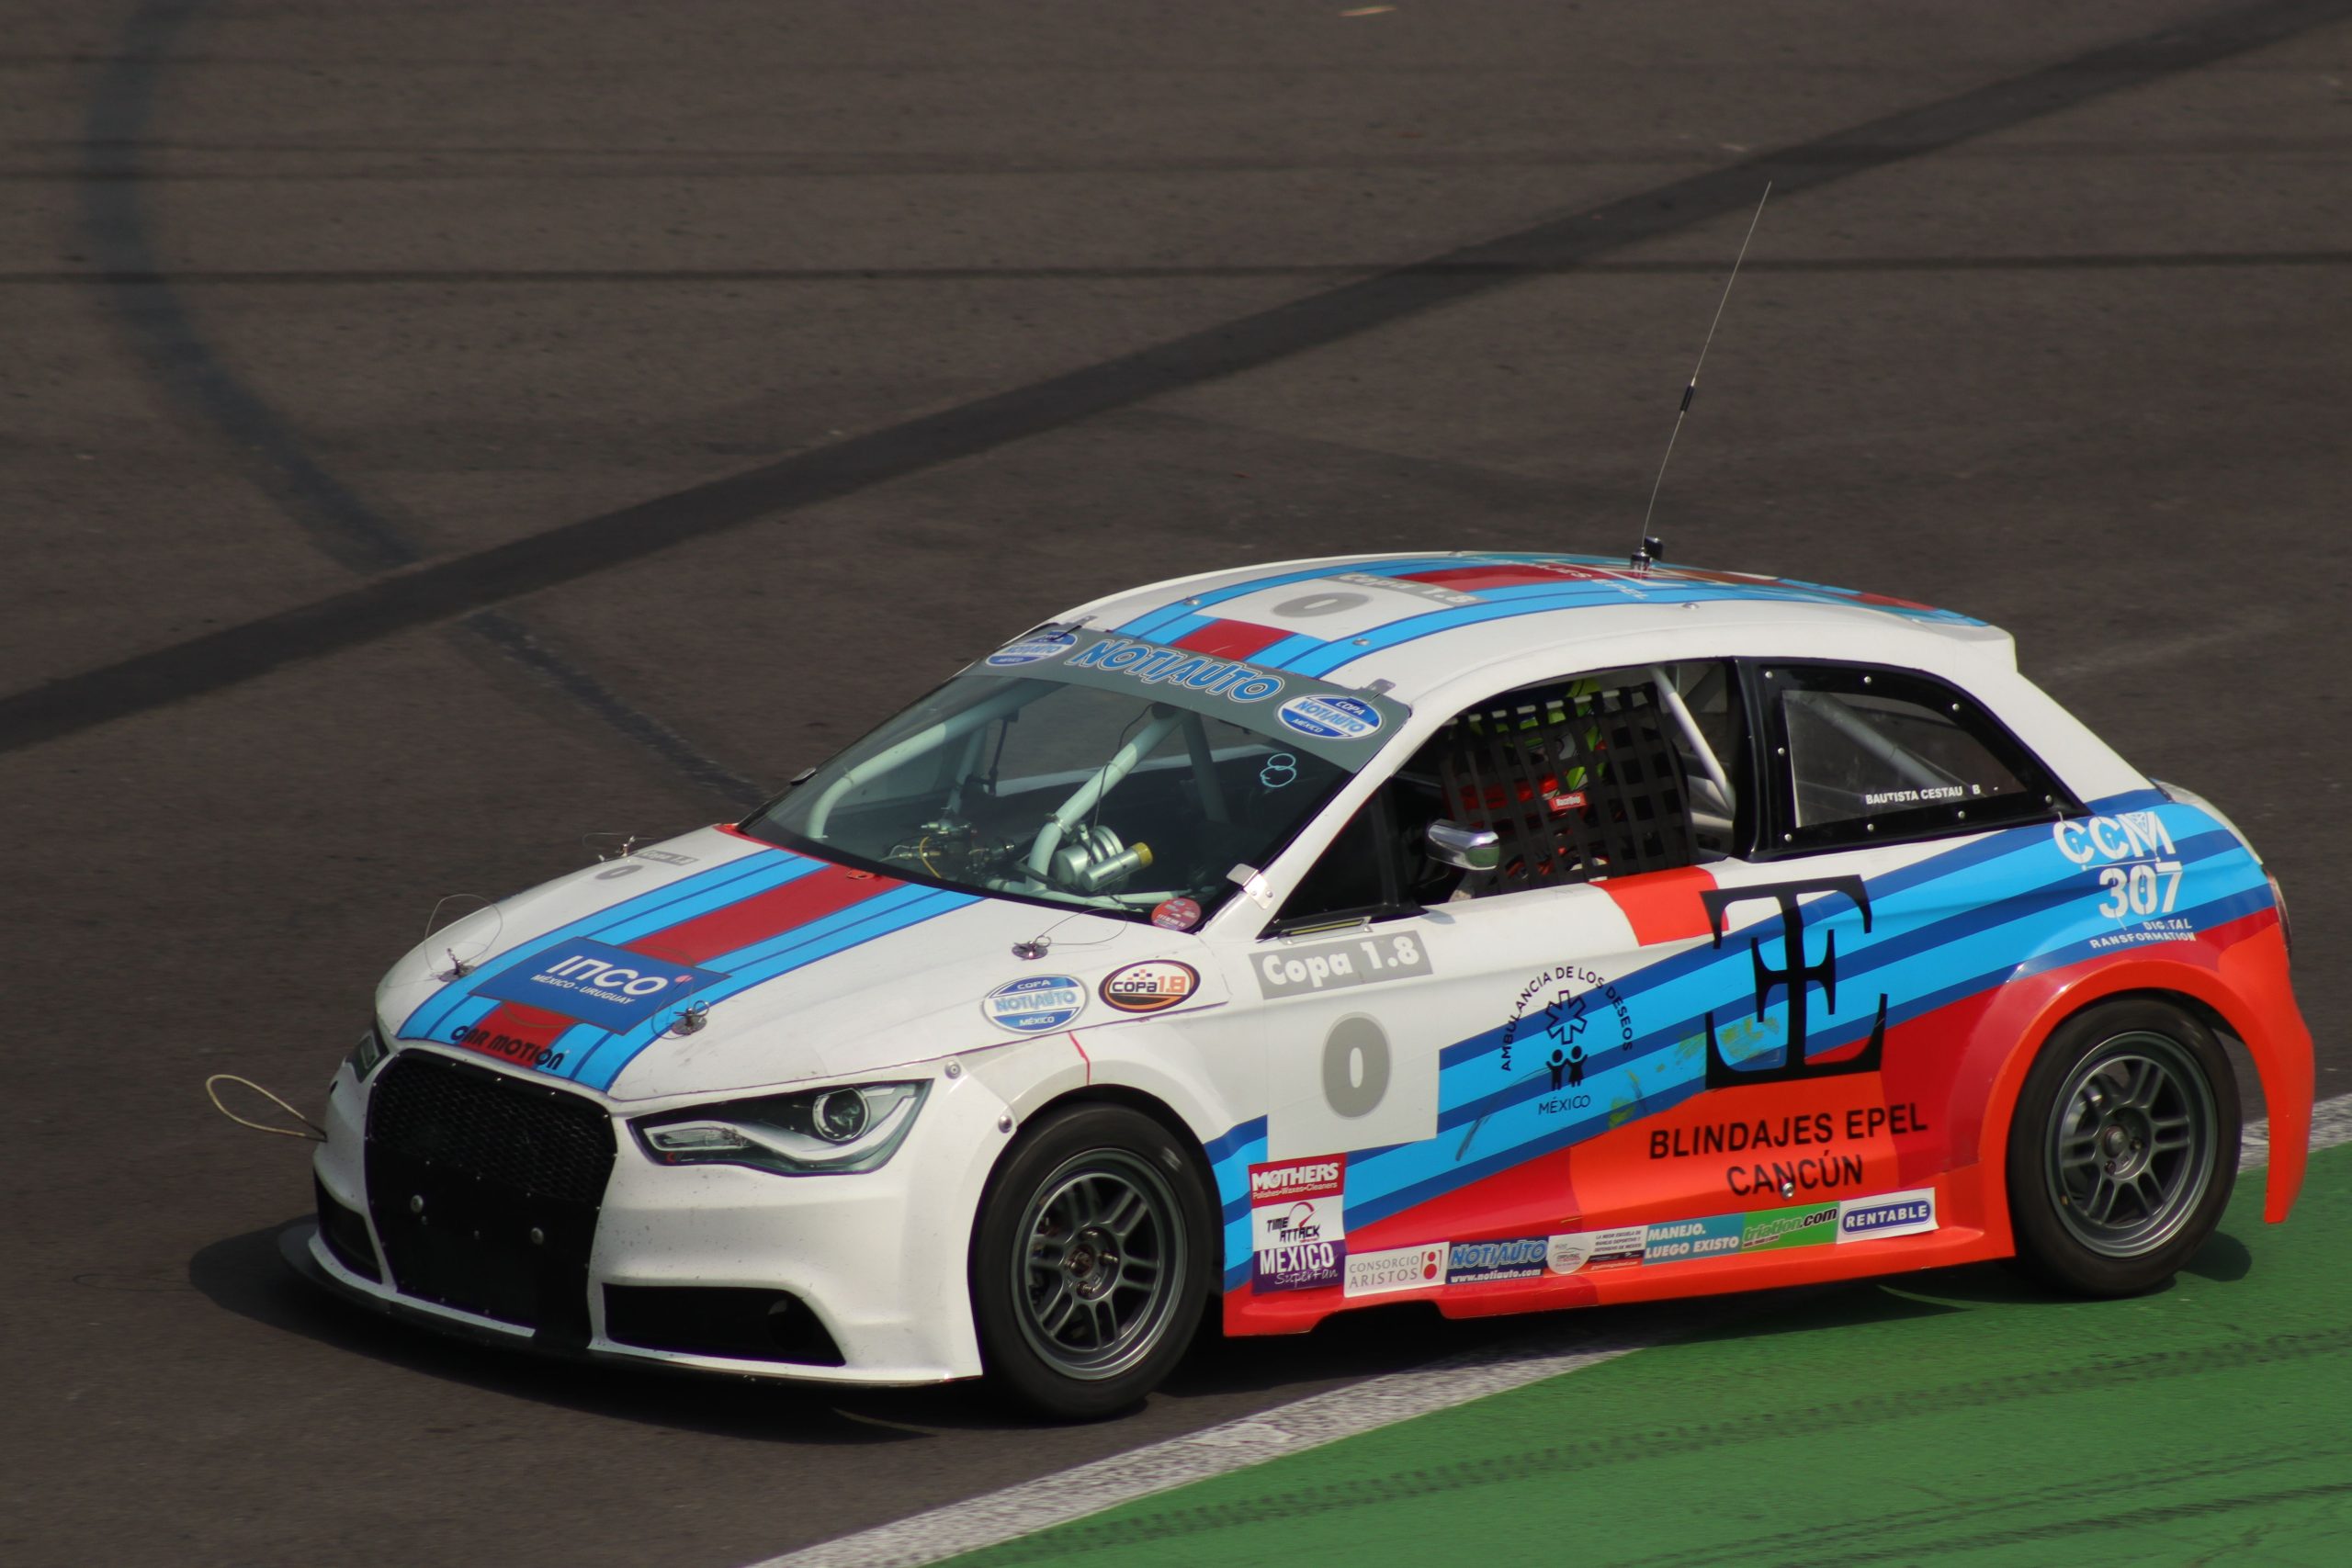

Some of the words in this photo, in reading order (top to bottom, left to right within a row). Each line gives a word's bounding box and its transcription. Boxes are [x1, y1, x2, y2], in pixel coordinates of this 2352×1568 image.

[1064, 637, 1285, 703] NOTIAUTO
[1293, 700, 1366, 732] NOTIAUTO
[1335, 701, 1366, 716] COPA
[1865, 789, 1918, 805] BAUTISTA
[1920, 785, 1962, 801] CESTAU
[2052, 811, 2176, 863] CCM
[2098, 861, 2183, 919] 307
[2143, 919, 2192, 931] DIGTAL
[1262, 953, 1353, 987] Copa
[1360, 936, 1419, 969] 1.8
[579, 986, 636, 1004] URUGUAY
[1017, 979, 1051, 990] COPA
[994, 990, 1079, 1012] NOTIAUTO
[1501, 972, 1553, 1071] AMBULANCIA
[1555, 966, 1574, 979] DE
[1578, 967, 1605, 989] LOS
[1605, 987, 1634, 1051] DESEOS
[450, 1025, 487, 1045] CAR
[1322, 1011, 1392, 1120] 0
[1538, 1094, 1591, 1115] MÉXICO
[1649, 1112, 1833, 1159] BLINDAJES
[1846, 1102, 1928, 1140] EPEL
[1251, 1163, 1340, 1191] MOTHERS
[1726, 1149, 1863, 1197] CANCÚN
[1266, 1216, 1288, 1233] TIME
[1847, 1205, 1928, 1228] RENTABLE
[1280, 1224, 1320, 1243] ATTACK
[1647, 1223, 1706, 1241] MANEJO.
[1260, 1242, 1335, 1275] MEXICO
[1448, 1240, 1548, 1269] NOTIAUTO
[1645, 1243, 1690, 1259] LUEGO
[1693, 1236, 1739, 1254] EXISTO
[1349, 1255, 1419, 1273] CONSORCIO
[1349, 1269, 1418, 1289] ARISTOS
[1450, 1269, 1541, 1283] www.notiauto.com
